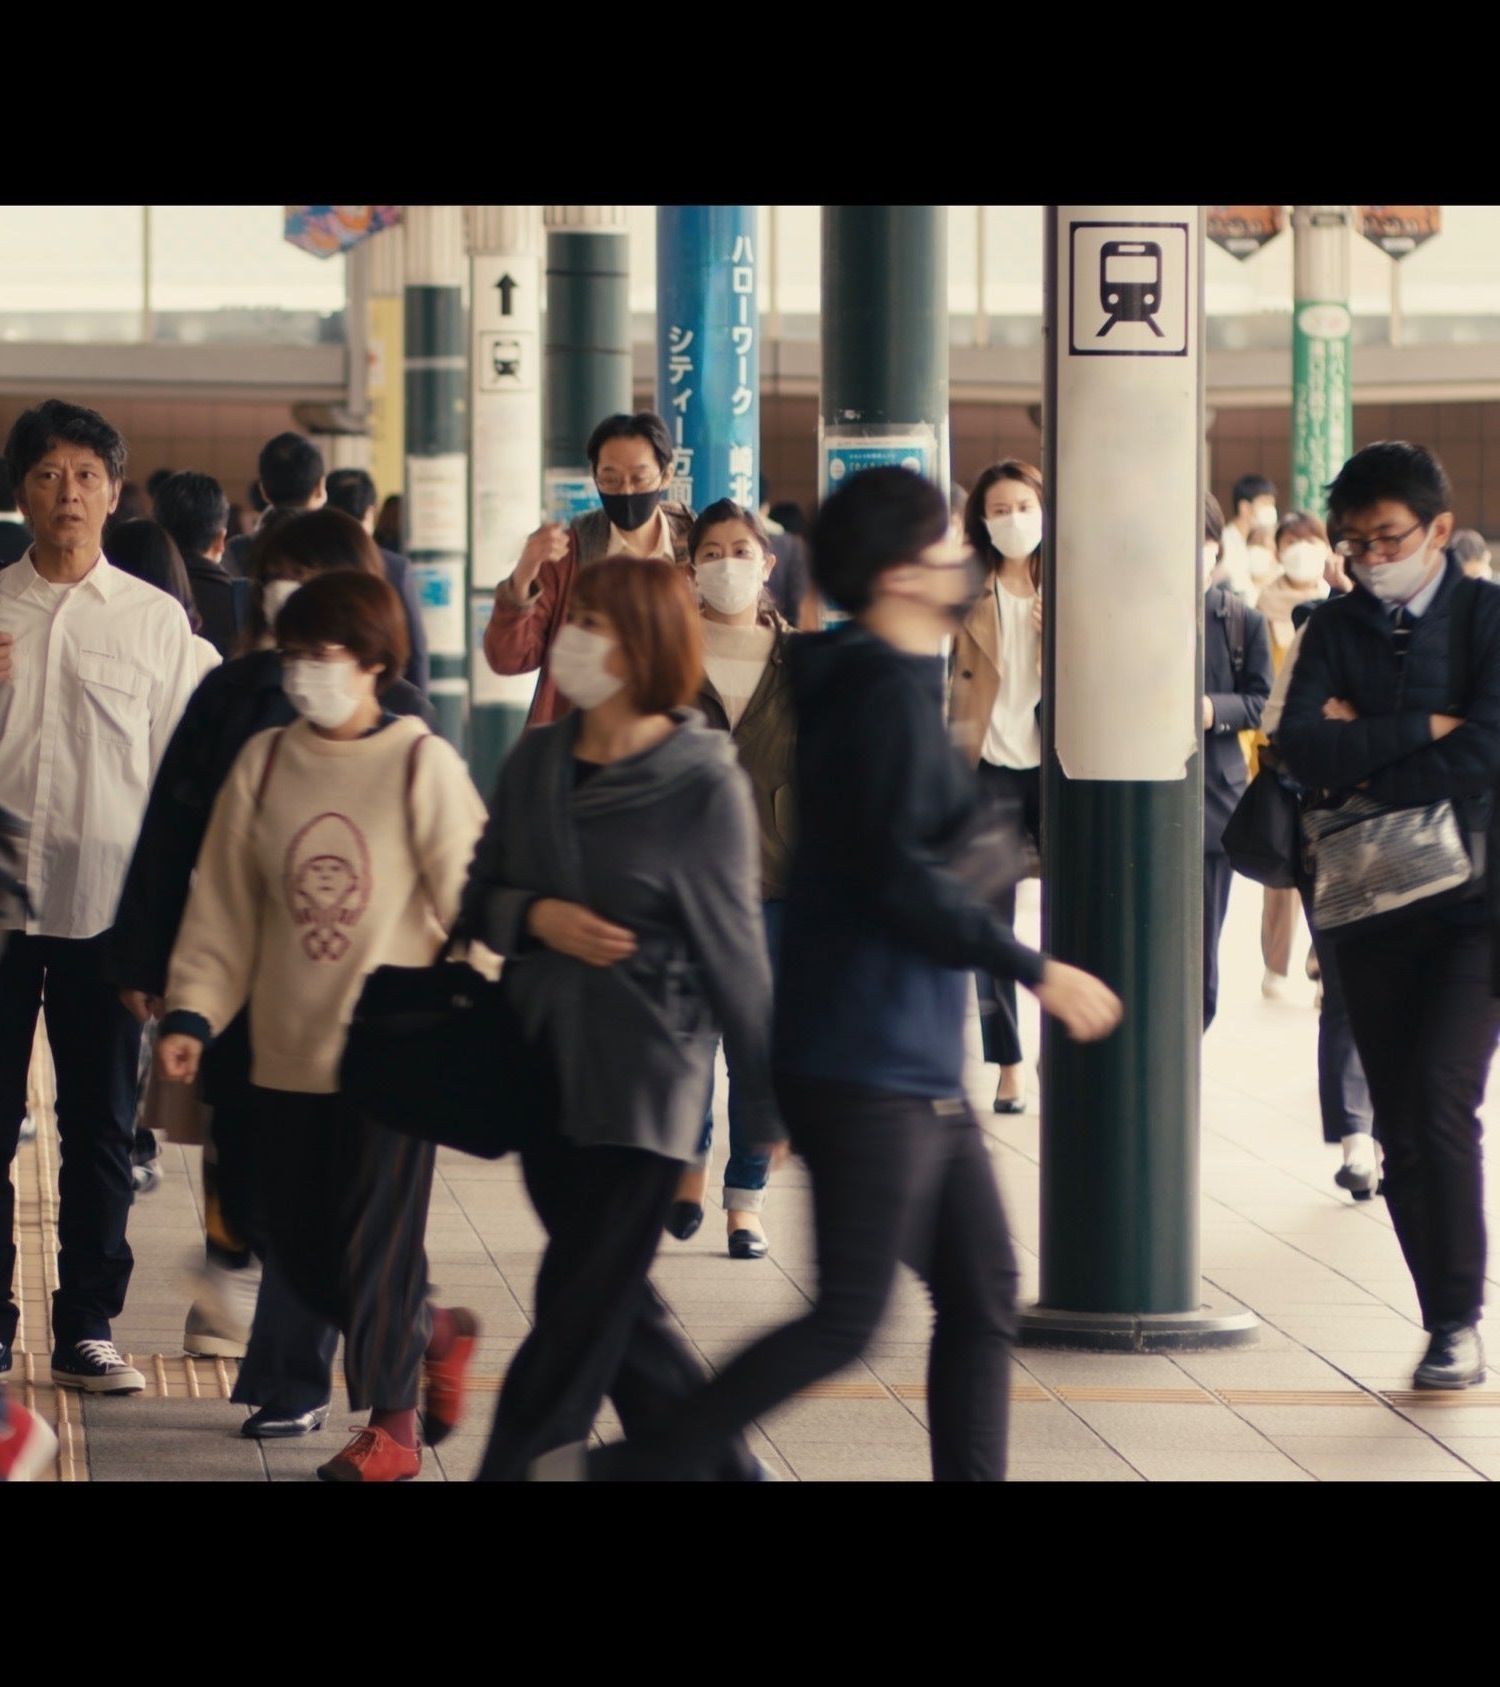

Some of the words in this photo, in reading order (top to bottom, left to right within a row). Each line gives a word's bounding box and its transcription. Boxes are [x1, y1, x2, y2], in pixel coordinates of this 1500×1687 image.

[731, 235, 754, 415] ハローワーク
[668, 325, 695, 506] シティー方面
